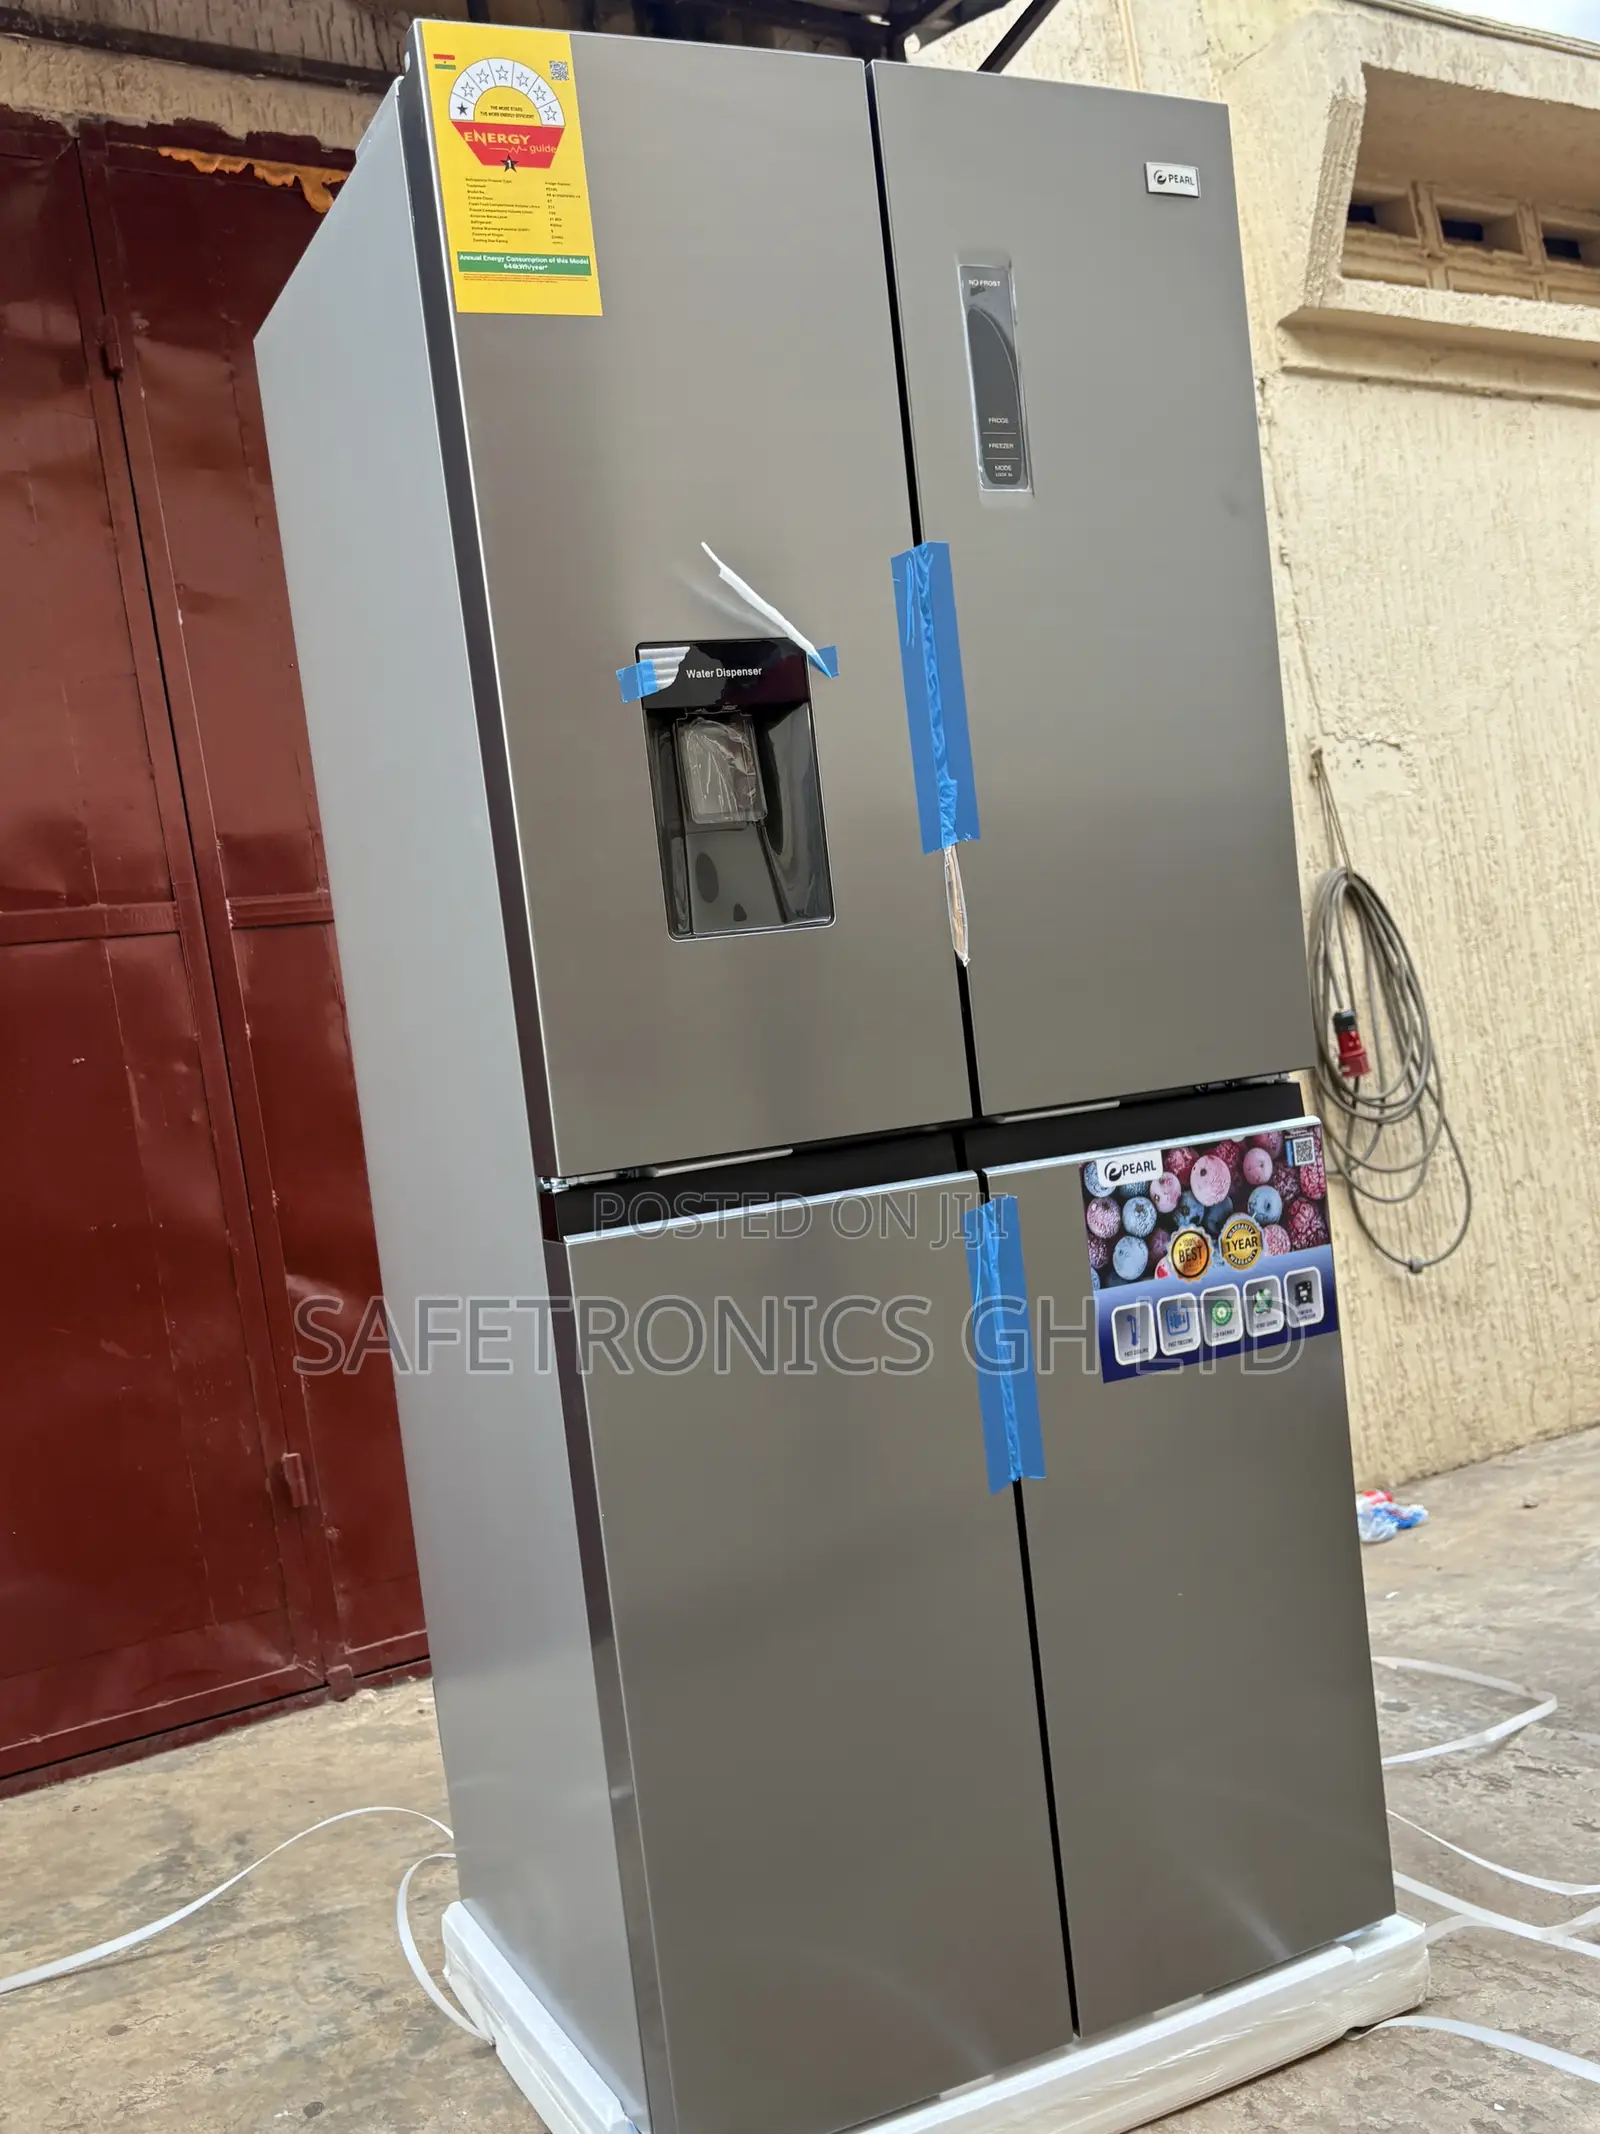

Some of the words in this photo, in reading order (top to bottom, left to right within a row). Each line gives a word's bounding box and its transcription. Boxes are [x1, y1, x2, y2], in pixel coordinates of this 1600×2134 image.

[463, 128, 531, 146] ENERGY
[529, 144, 557, 154] guide
[507, 160, 512, 168] 1
[1168, 174, 1195, 186] PEARL
[483, 255, 505, 263] Energy
[506, 256, 548, 264] Consumption
[968, 279, 979, 287] NO
[685, 669, 714, 679] Water
[715, 668, 763, 679] Dispenser
[1122, 1160, 1157, 1176] PEARL
[1226, 1241, 1231, 1252] 1
[1231, 1236, 1259, 1251] YEAR
[1178, 1245, 1204, 1263] BEST
